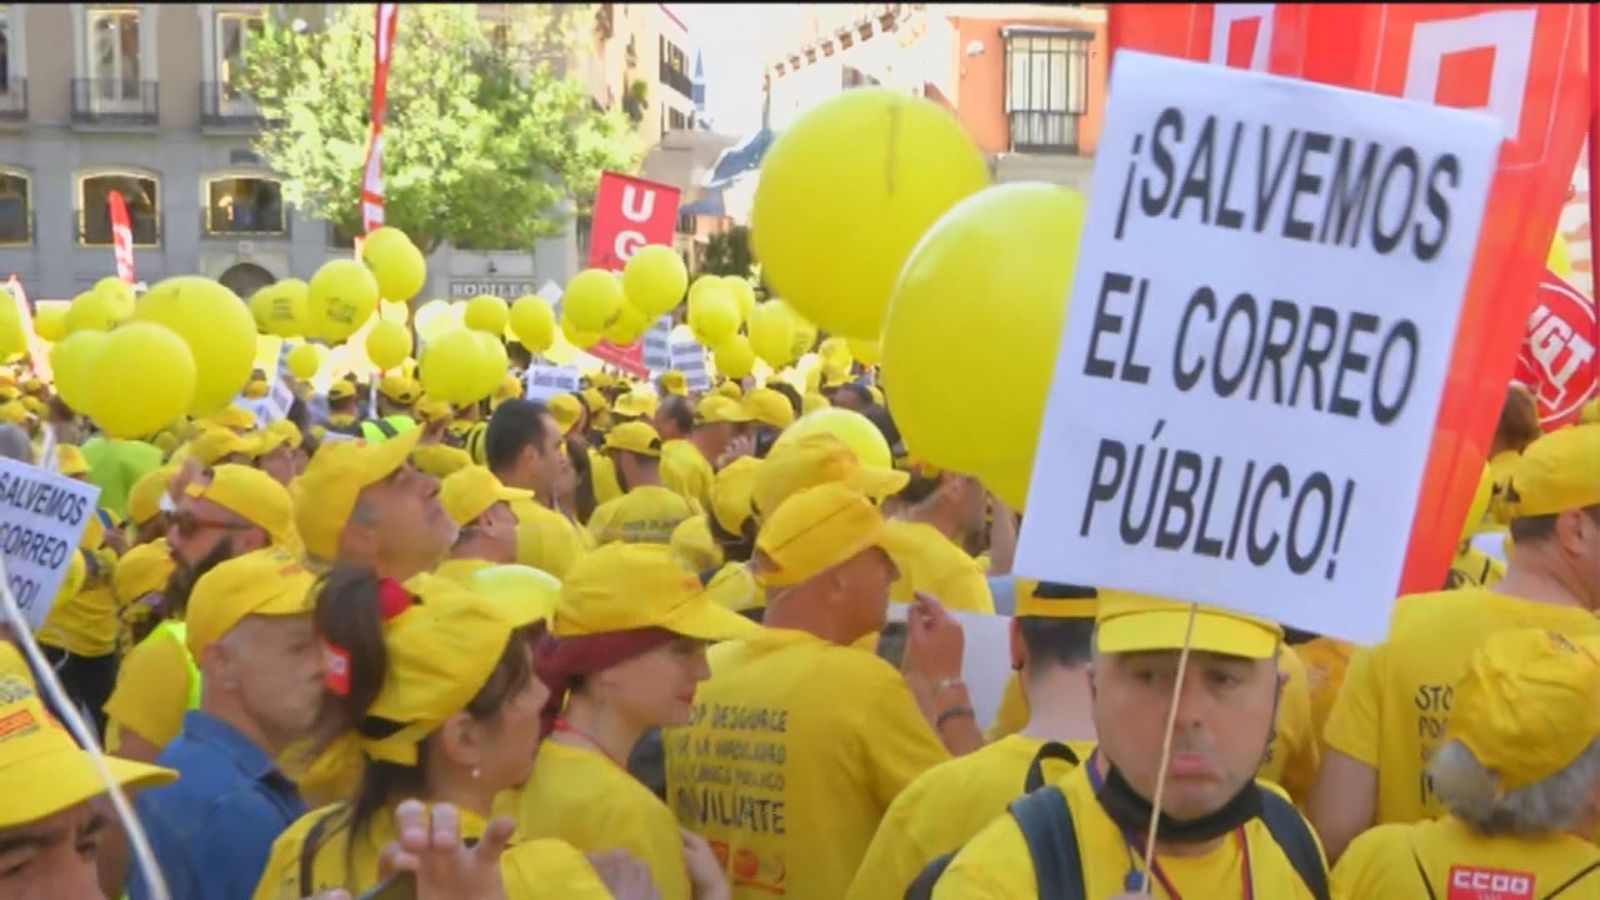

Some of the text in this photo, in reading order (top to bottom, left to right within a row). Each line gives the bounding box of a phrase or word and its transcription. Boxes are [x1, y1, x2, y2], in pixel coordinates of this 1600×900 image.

[613, 184, 656, 272] UG
[1114, 107, 1461, 262] ¡SALVEMOS
[1083, 271, 1420, 426] EL CORREO
[1080, 419, 1356, 581] PÚBLICO!
[1415, 684, 1454, 711] STO
